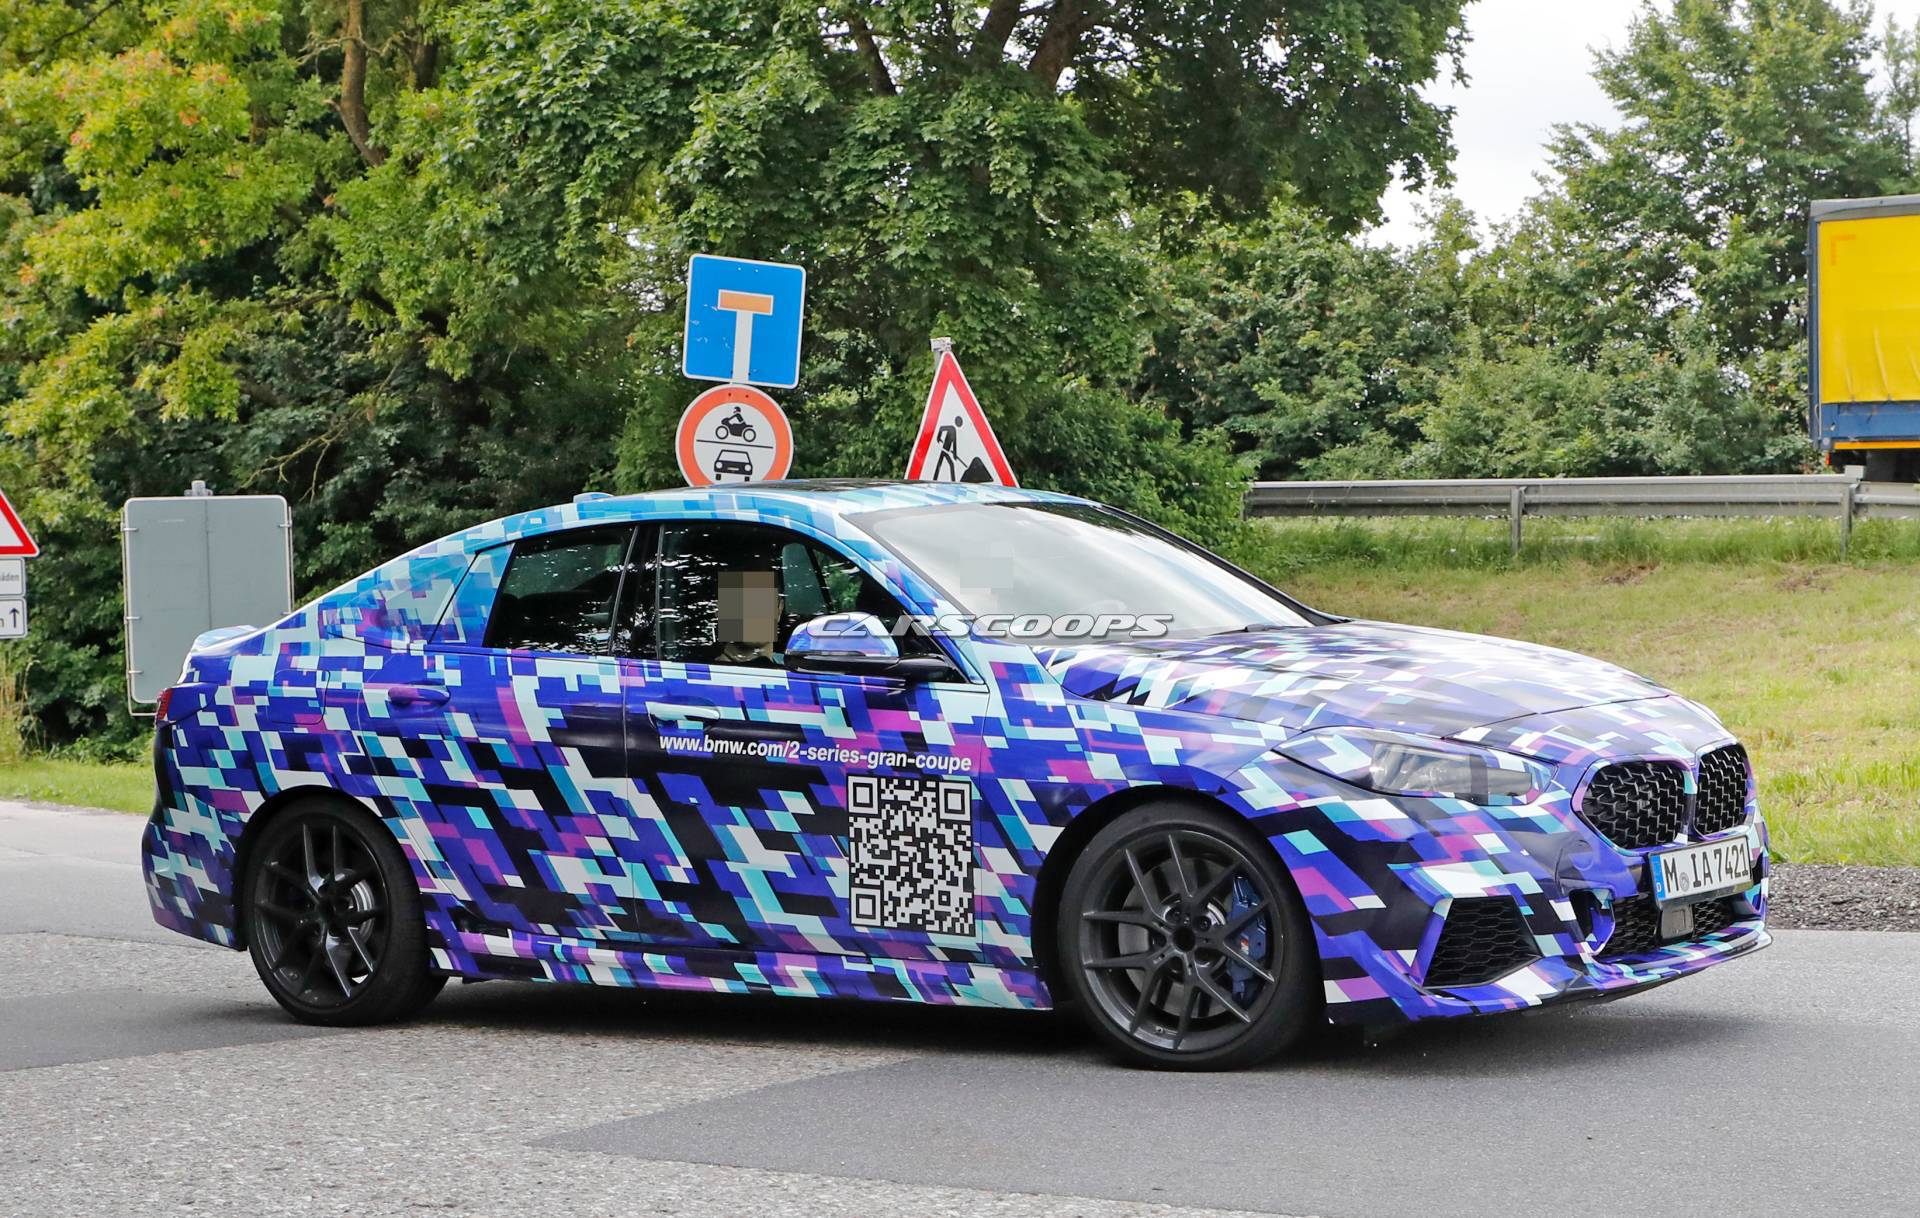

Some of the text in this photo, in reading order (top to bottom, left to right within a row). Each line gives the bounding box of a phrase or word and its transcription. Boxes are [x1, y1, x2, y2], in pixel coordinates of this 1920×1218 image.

[0, 571, 19, 581] äden
[659, 734, 972, 774] www.bmw.com/2-series-gran-coupe
[1663, 857, 1680, 893] M
